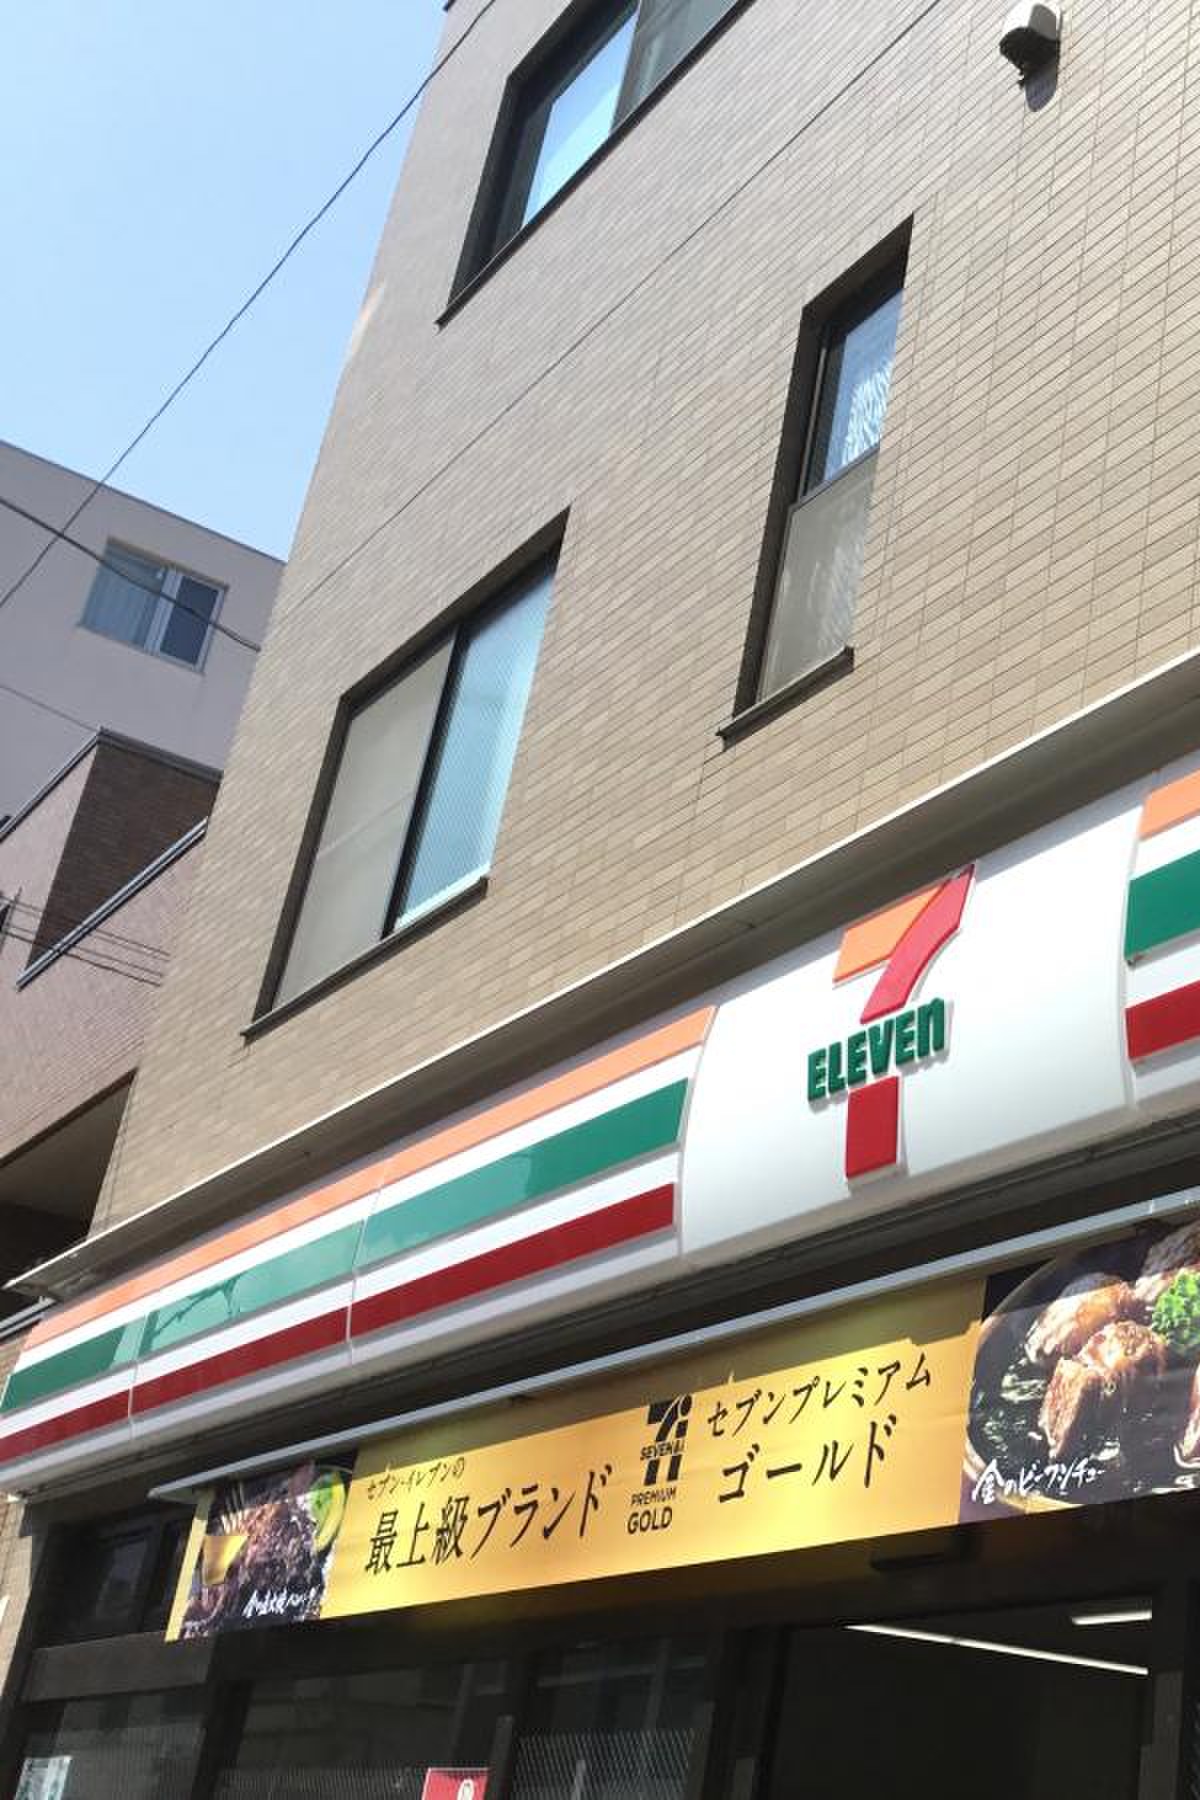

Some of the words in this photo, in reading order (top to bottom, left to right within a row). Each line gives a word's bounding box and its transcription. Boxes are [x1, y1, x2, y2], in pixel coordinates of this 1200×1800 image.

[832, 863, 976, 1180] 7
[706, 1352, 932, 1438] セブンプレミアム
[629, 1486, 677, 1506] PREMIUM
[718, 1414, 897, 1503] ゴールド
[364, 1463, 613, 1576] 最上級ブランド
[626, 1505, 673, 1535] GOLD
